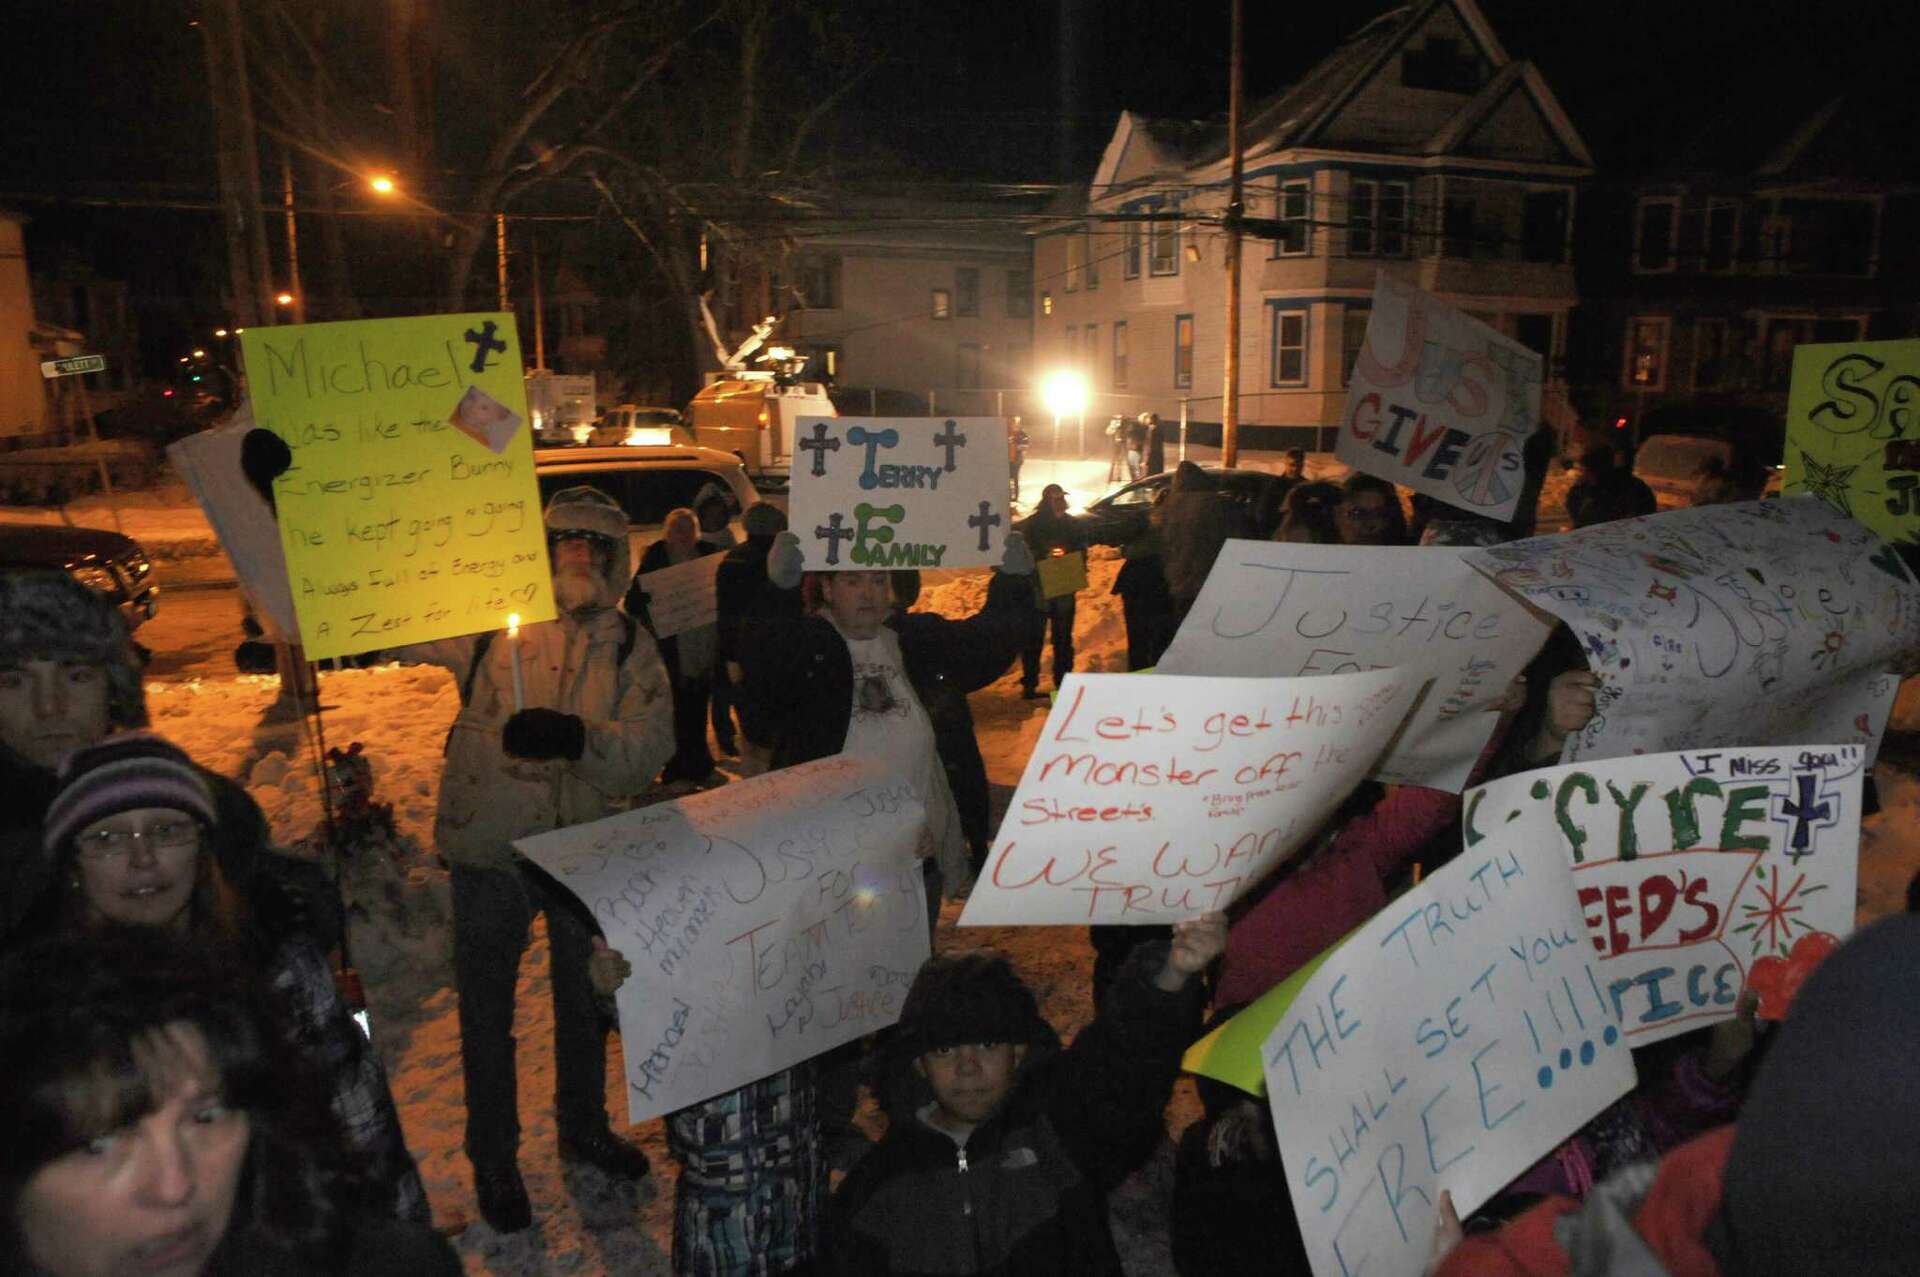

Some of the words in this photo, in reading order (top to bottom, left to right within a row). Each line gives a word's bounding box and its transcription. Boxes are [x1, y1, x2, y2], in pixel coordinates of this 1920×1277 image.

[262, 338, 464, 399] Michael
[357, 413, 399, 443] like
[411, 415, 448, 432] the
[847, 426, 942, 490] TERRY
[1351, 392, 1472, 481] GIVE
[277, 466, 432, 501] Energizer
[449, 454, 516, 482] Bunny
[346, 508, 401, 552] kept
[851, 502, 946, 567] FAMILY
[1212, 563, 1501, 643] Justice
[1055, 686, 1178, 743] Let's
[1193, 705, 1273, 751] get
[1271, 974, 1362, 1095] THE
[1381, 850, 1524, 967] TRUTH
[1304, 1067, 1408, 1213] SHALL
[1416, 963, 1498, 1059] SET
[1509, 928, 1578, 982] YOU
